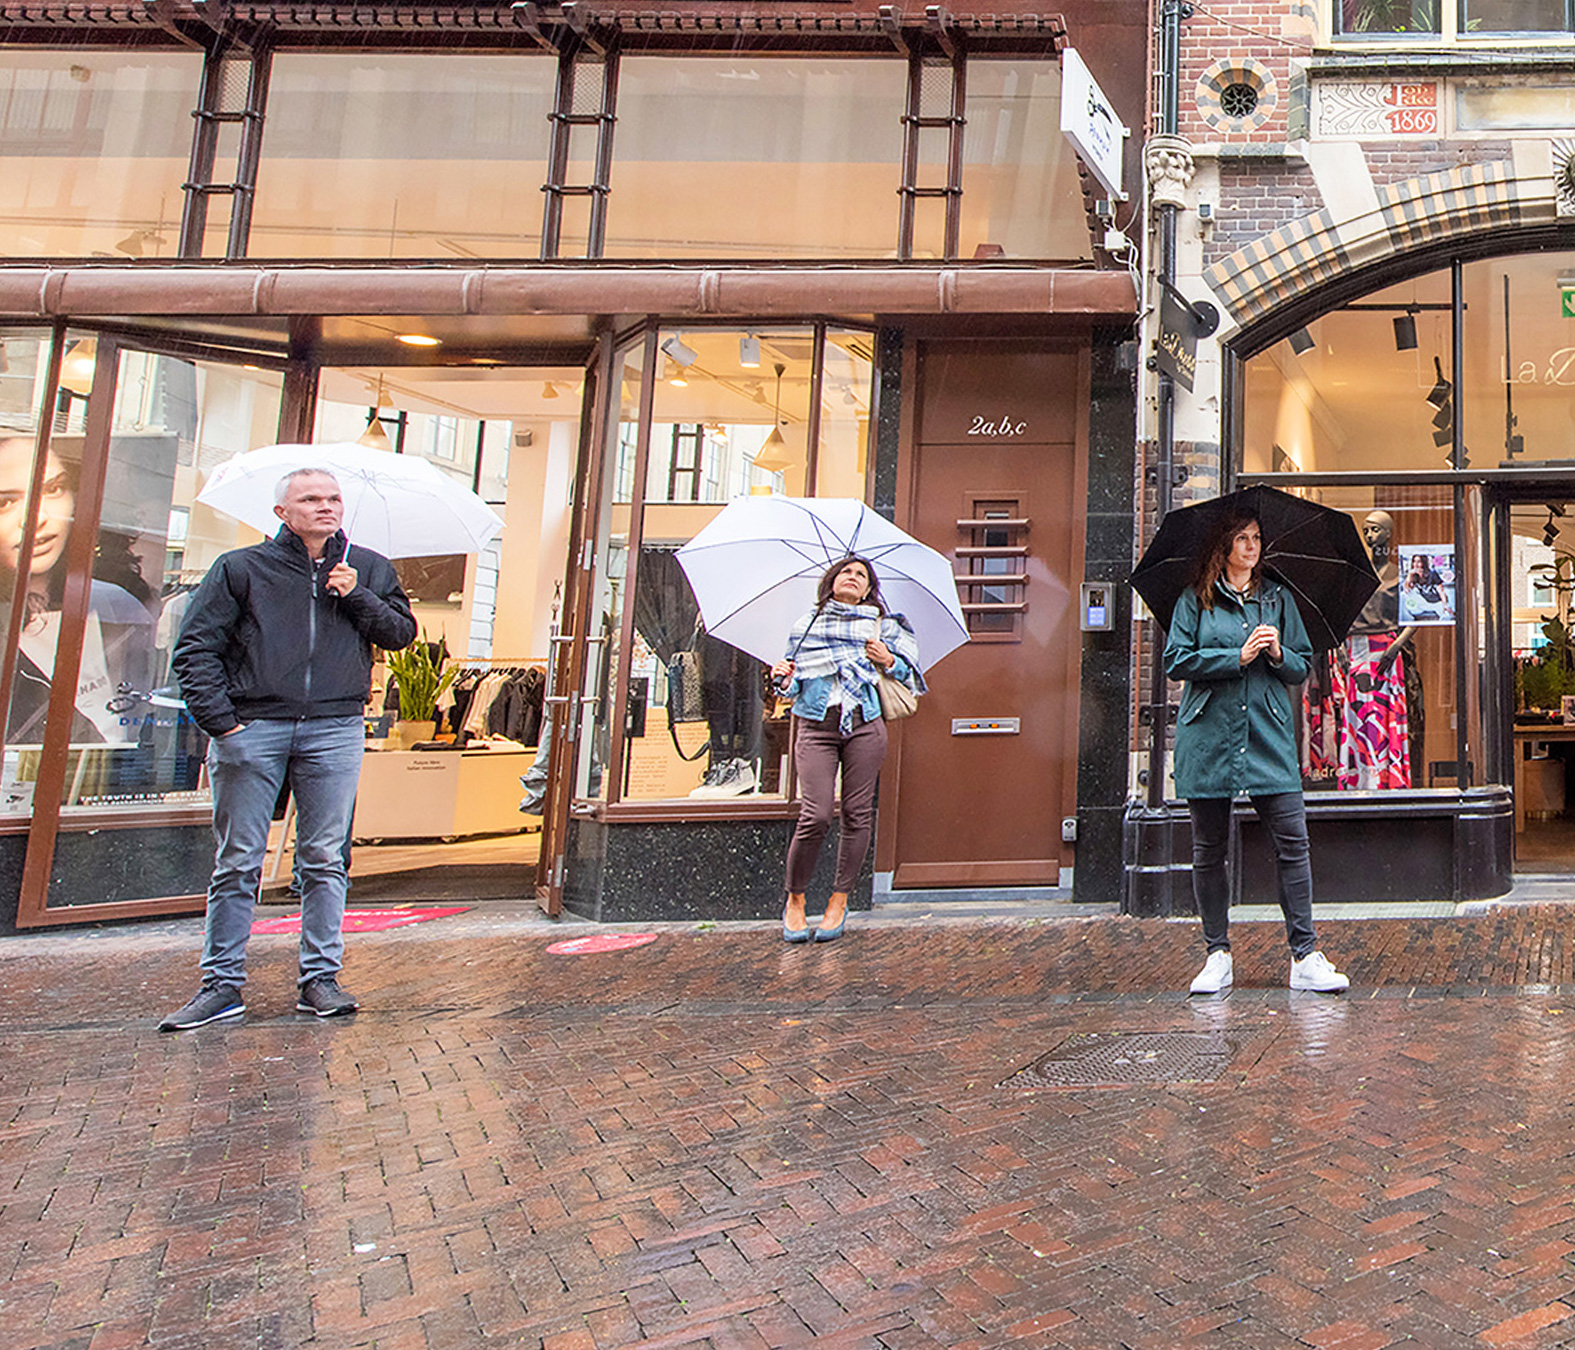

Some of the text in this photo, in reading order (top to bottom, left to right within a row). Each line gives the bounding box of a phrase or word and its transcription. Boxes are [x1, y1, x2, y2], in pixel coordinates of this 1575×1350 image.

[1393, 110, 1437, 134] 1869
[1500, 356, 1538, 384] La
[967, 415, 1027, 437] 2a,b,c
